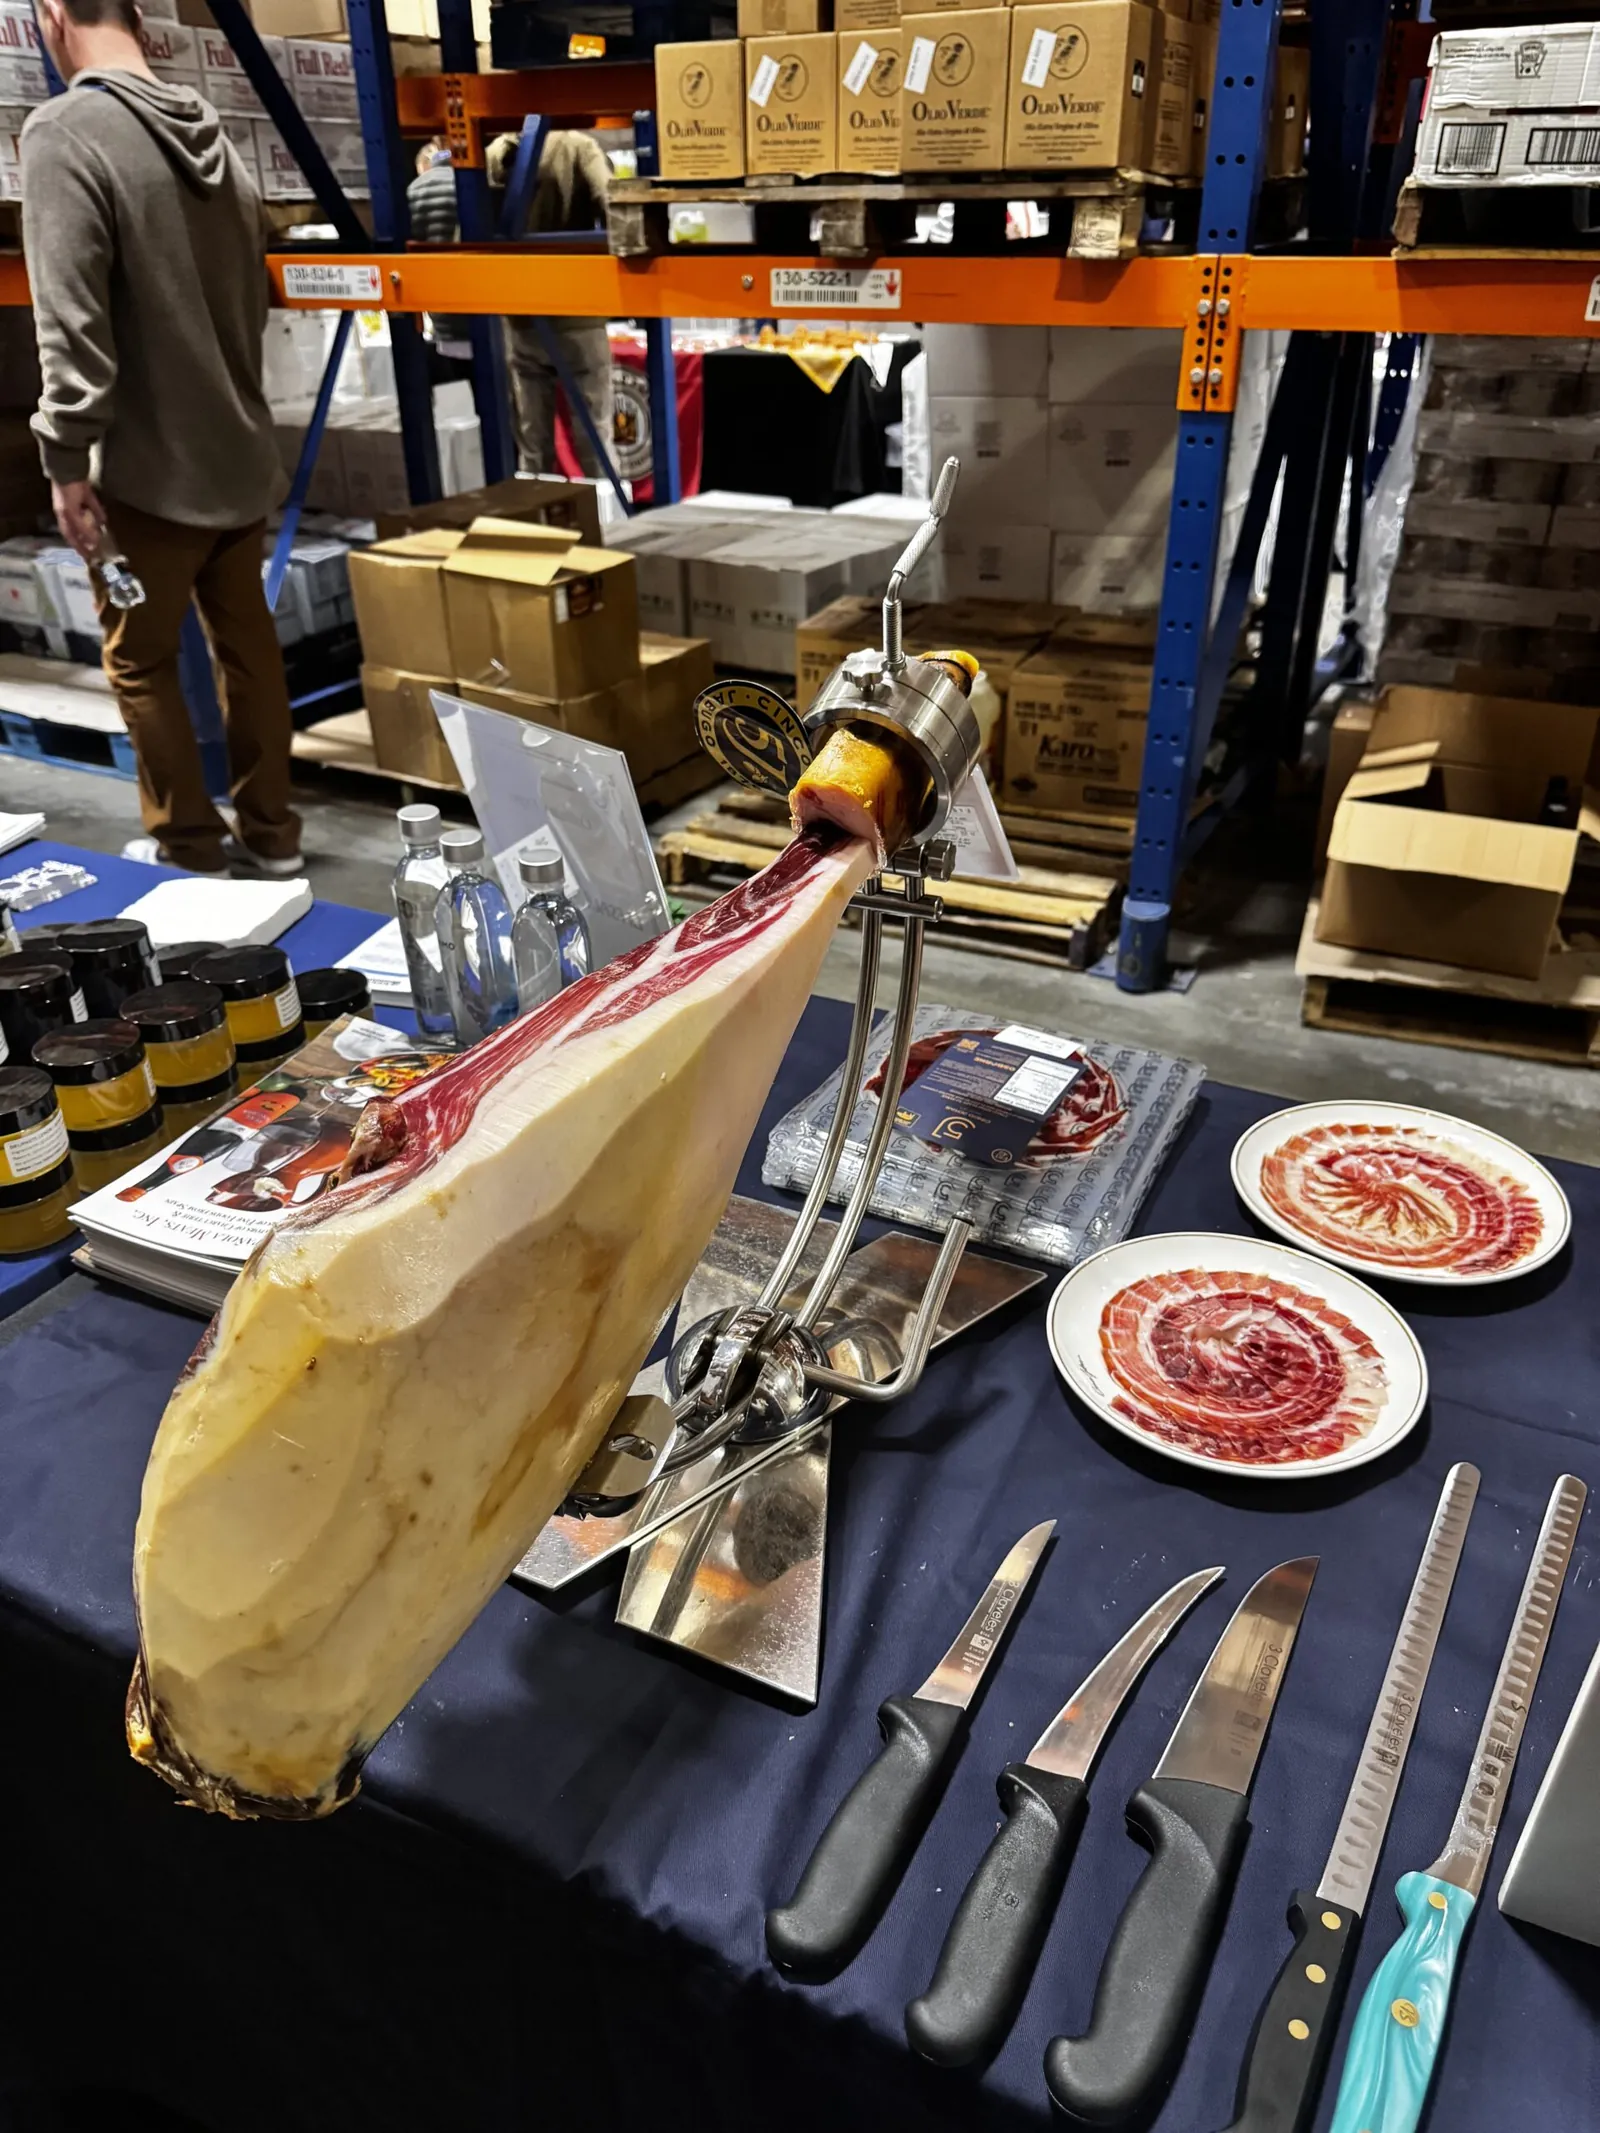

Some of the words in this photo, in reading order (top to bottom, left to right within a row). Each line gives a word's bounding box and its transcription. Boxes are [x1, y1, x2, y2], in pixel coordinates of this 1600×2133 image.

[775, 271, 852, 286] 130-522-1
[757, 696, 811, 766] CINCO
[1040, 734, 1095, 759] Karo
[931, 1116, 976, 1140] 5J
[985, 1588, 1015, 1633] Claveles
[1387, 1702, 1413, 1753] Claveles
